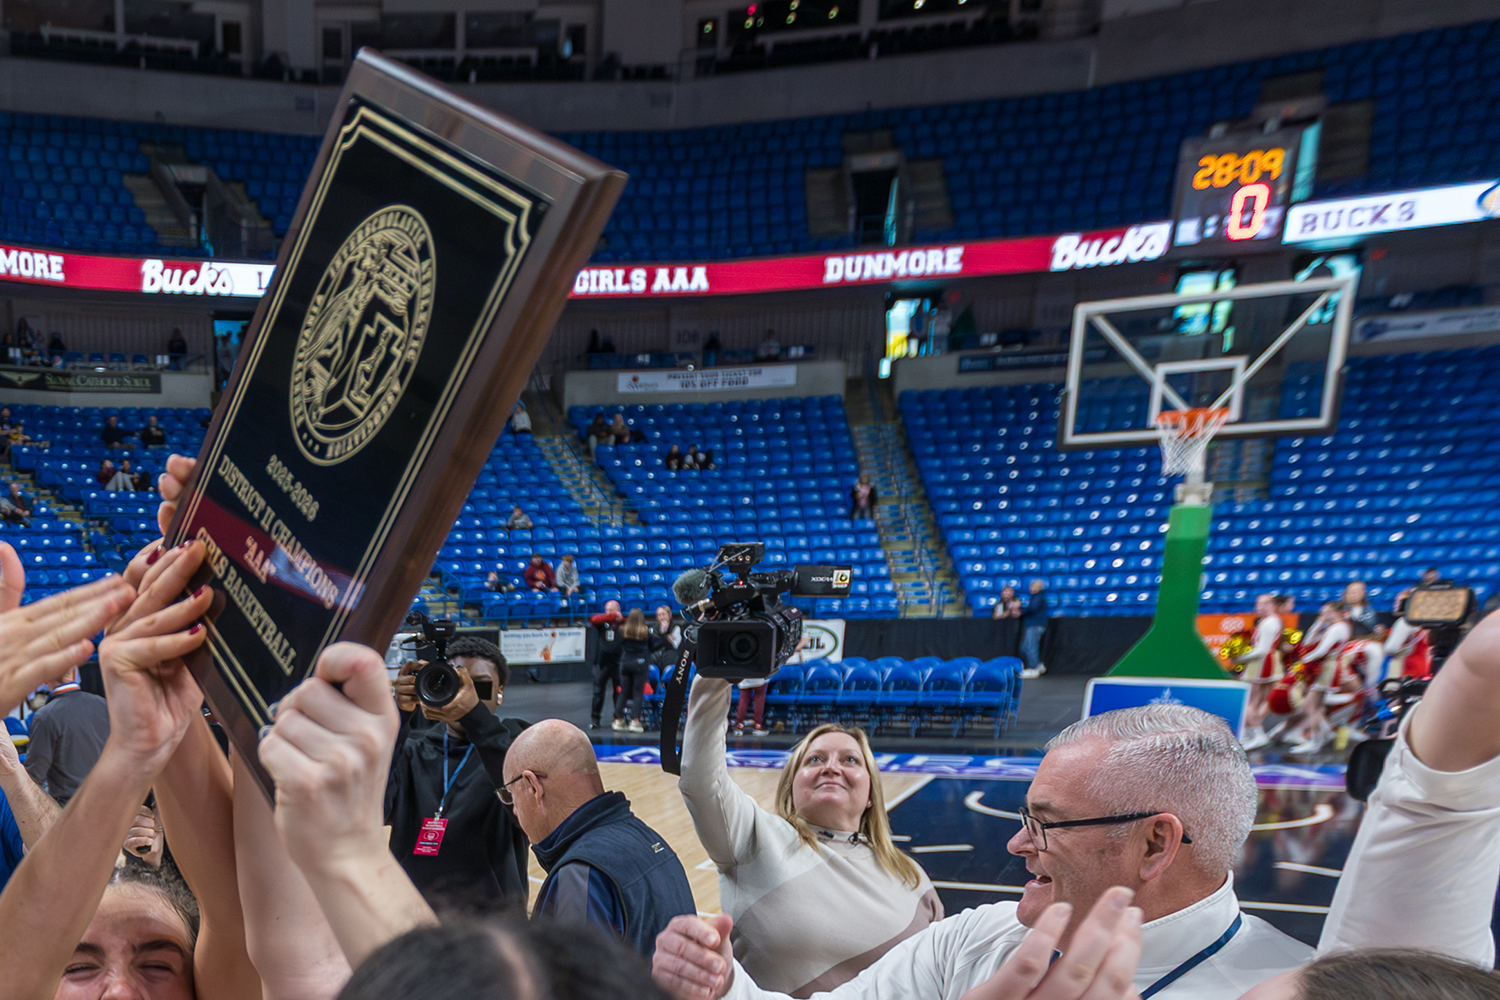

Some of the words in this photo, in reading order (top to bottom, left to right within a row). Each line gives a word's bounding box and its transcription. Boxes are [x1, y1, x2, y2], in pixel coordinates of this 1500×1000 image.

[1191, 148, 1285, 190] 28:09
[1225, 181, 1271, 241] 0
[1299, 200, 1417, 234] BUCKS
[824, 247, 964, 284] DUNMORE
[1050, 221, 1171, 272] Bucks
[141, 258, 234, 296] Bucks
[573, 267, 647, 294] GIRLS
[651, 265, 709, 293] AAA
[265, 454, 320, 522] 2025-2026
[217, 455, 267, 518] DISTRICT
[256, 504, 278, 532] II
[269, 521, 340, 610] CHAMPIONS
[220, 565, 298, 677] BASKETBALL
[675, 649, 690, 685] SONY
